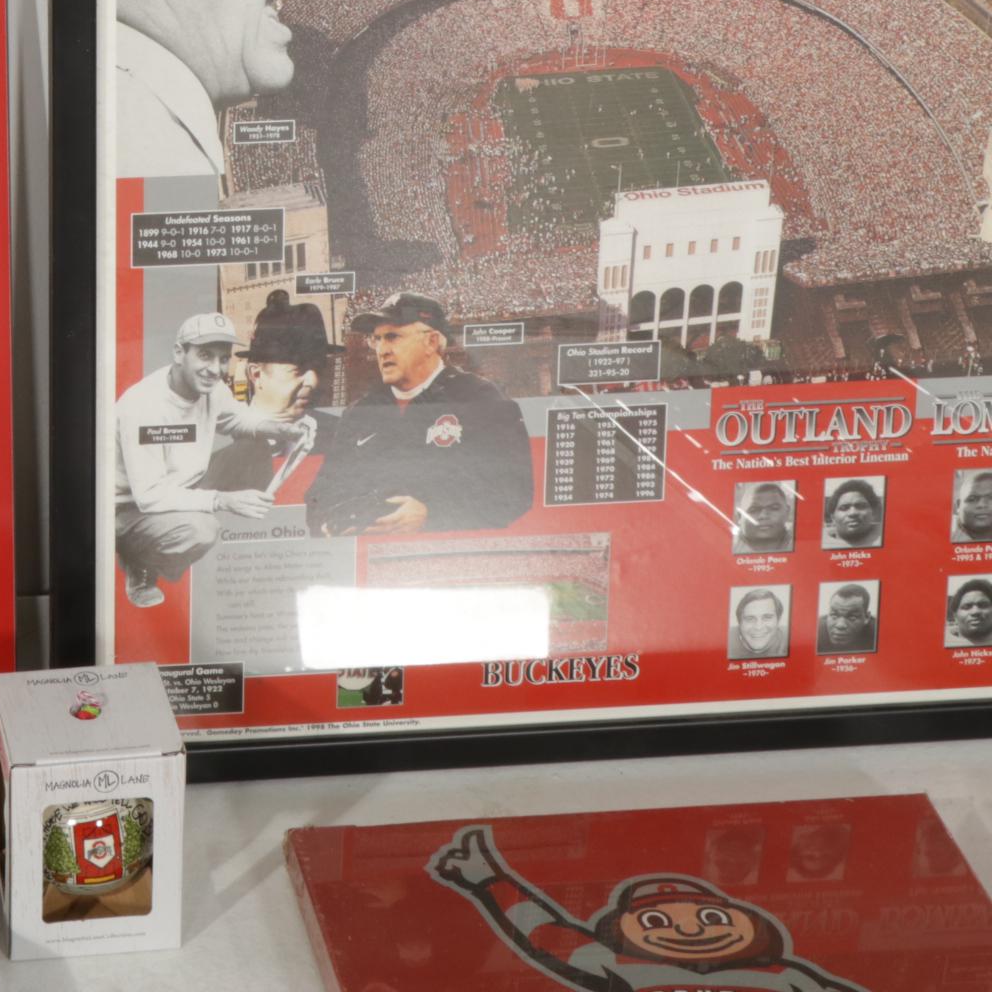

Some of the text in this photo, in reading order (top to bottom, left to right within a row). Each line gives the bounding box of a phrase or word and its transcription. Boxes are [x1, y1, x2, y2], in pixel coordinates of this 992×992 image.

[624, 182, 765, 201] Ohio Stadium
[165, 215, 251, 225] Undefeated Seasons
[188, 227, 209, 235] 1916
[231, 225, 250, 233] 1917
[206, 249, 227, 257] 1973
[567, 345, 652, 356] Ohio Stadium Record
[588, 409, 657, 420] Championships
[716, 403, 912, 446] OUTLAND
[831, 439, 889, 452] TROPHY
[712, 451, 909, 470] The Nation's Best Interior Lineman
[220, 526, 305, 541] Carmen Ohio
[196, 667, 224, 675] Game
[481, 653, 640, 687] BUCKEYES
[45, 779, 92, 791] MAGNOLIA
[121, 774, 150, 785] LANE
